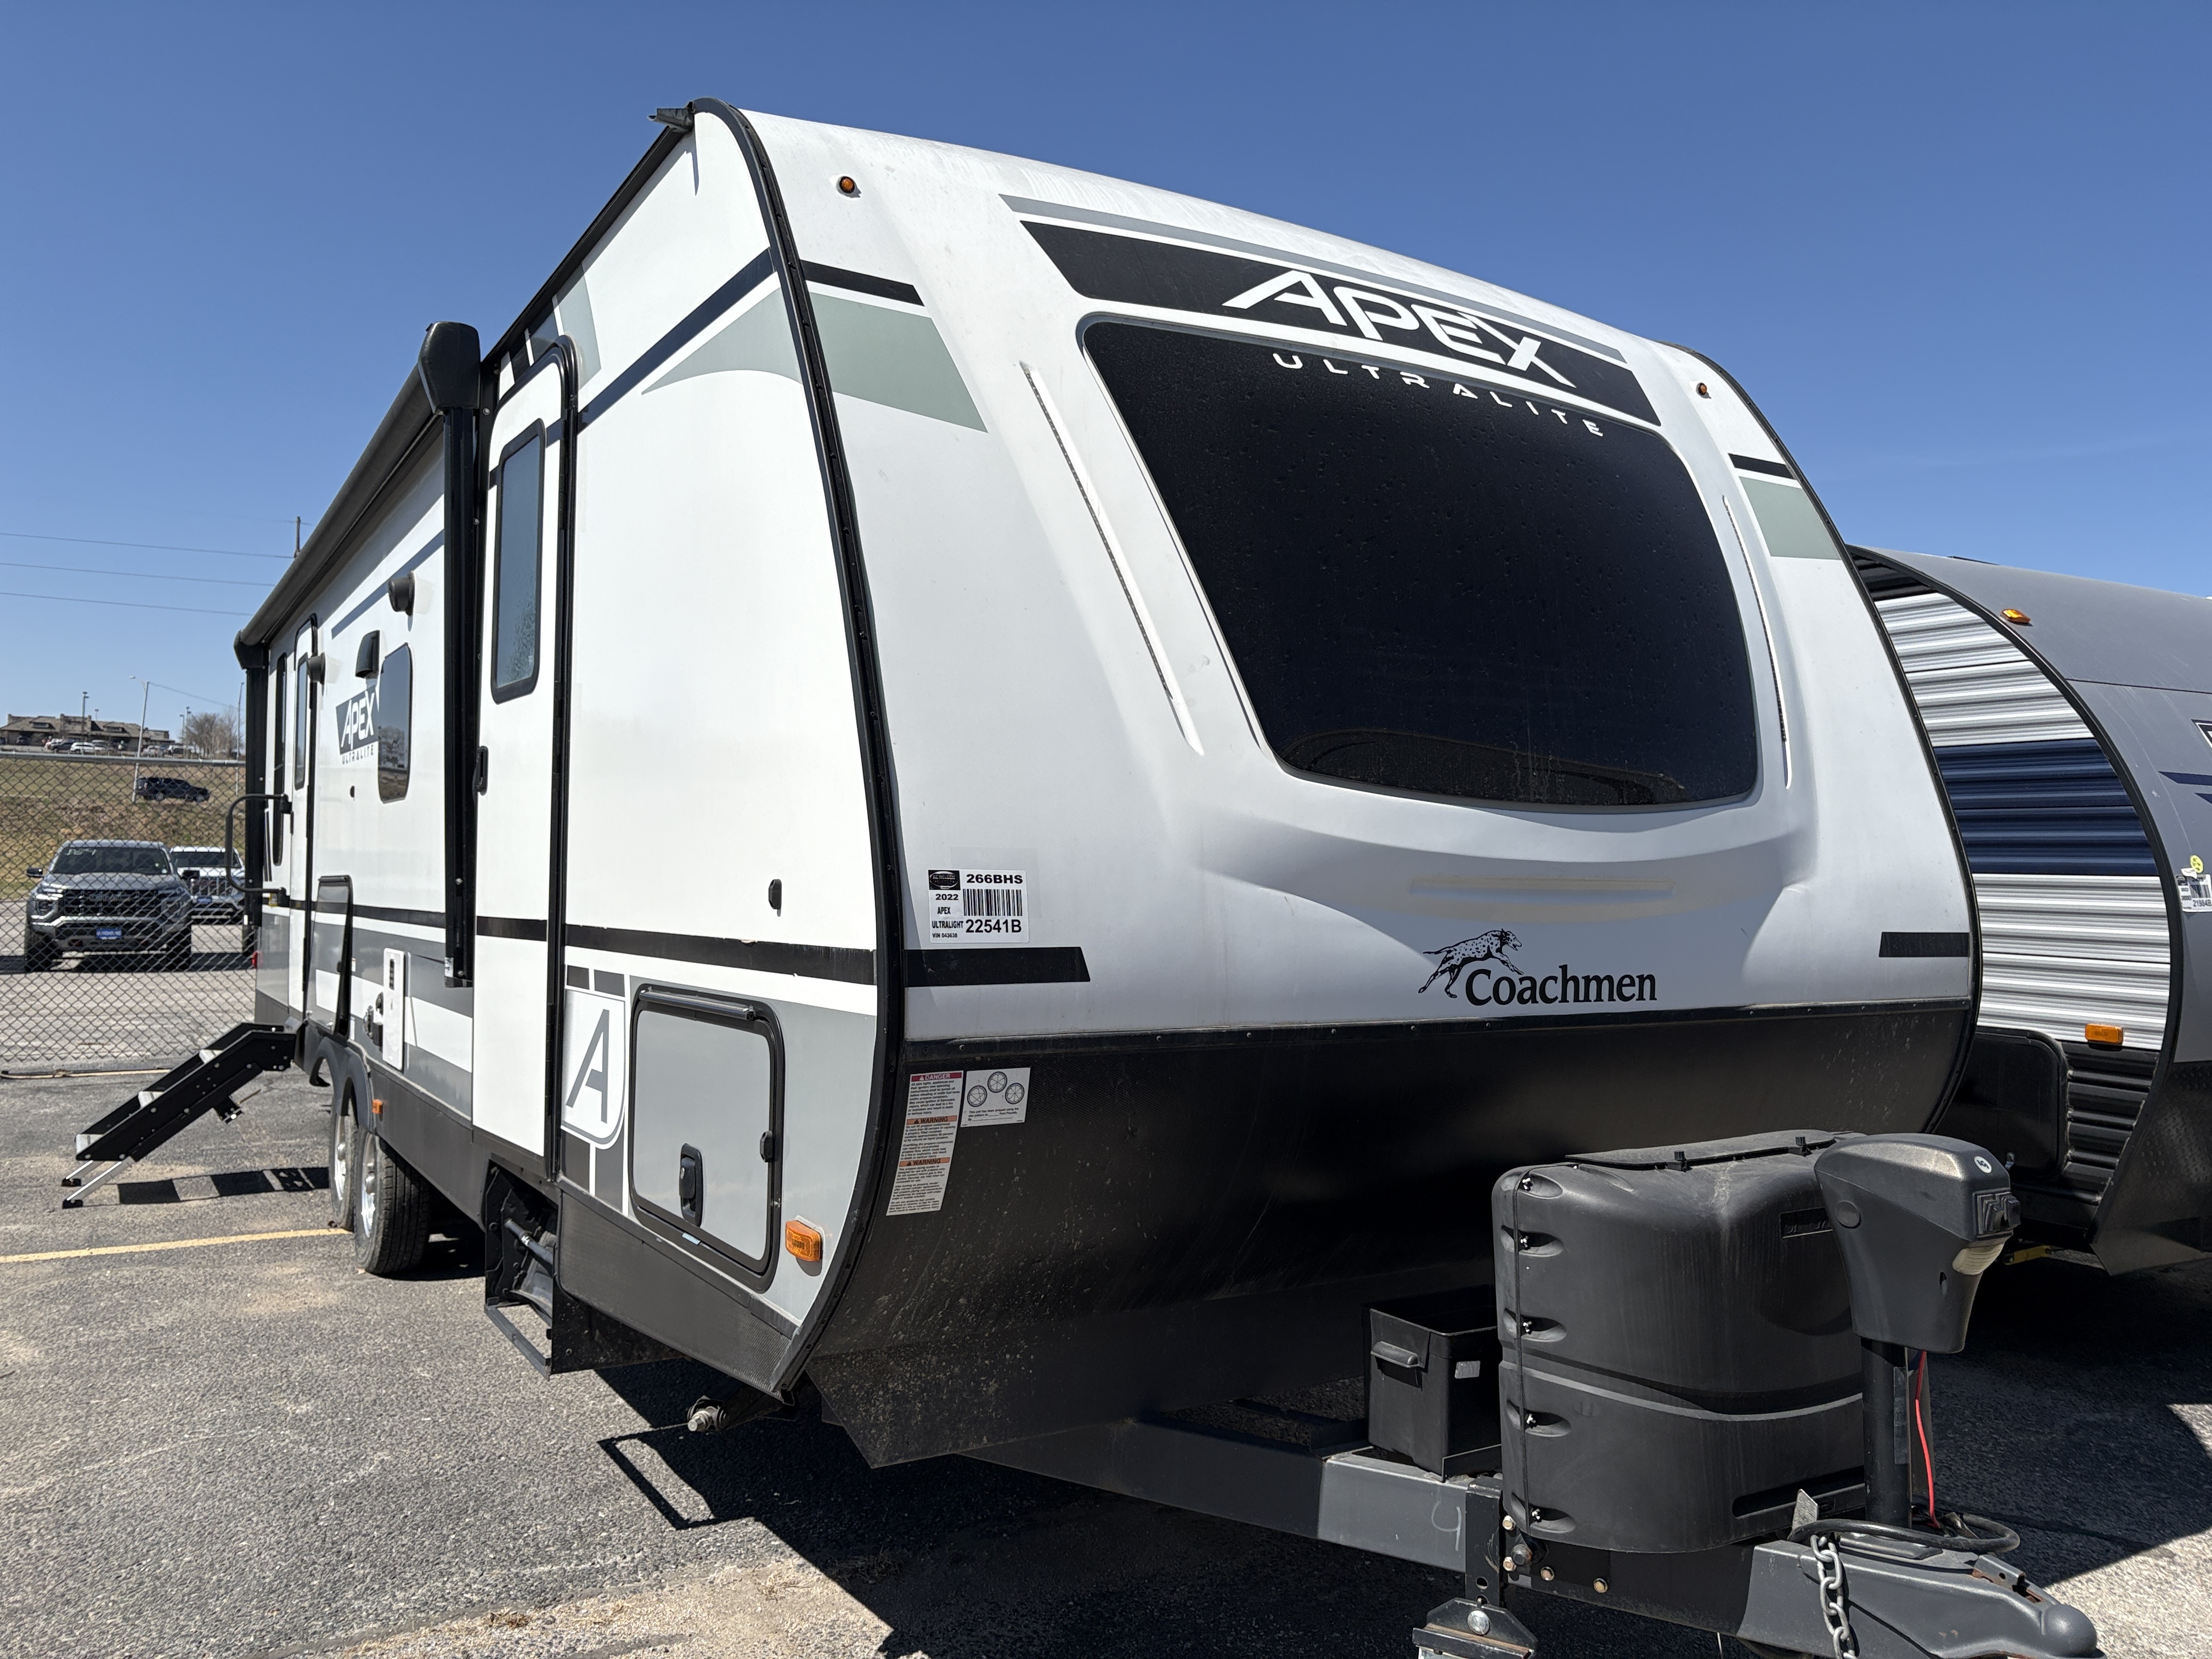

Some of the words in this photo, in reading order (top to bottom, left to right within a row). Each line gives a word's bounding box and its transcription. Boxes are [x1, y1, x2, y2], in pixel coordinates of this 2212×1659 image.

[1222, 269, 1577, 388] APEX
[1273, 353, 1604, 437] ULTRALITE
[341, 691, 375, 750] APEX
[966, 874, 1023, 884] 266BHS
[932, 921, 964, 929] ULTRALIGHT
[966, 919, 1022, 933] 22541B
[1465, 964, 1657, 1006] Coachmen
[566, 1009, 610, 1124] A
